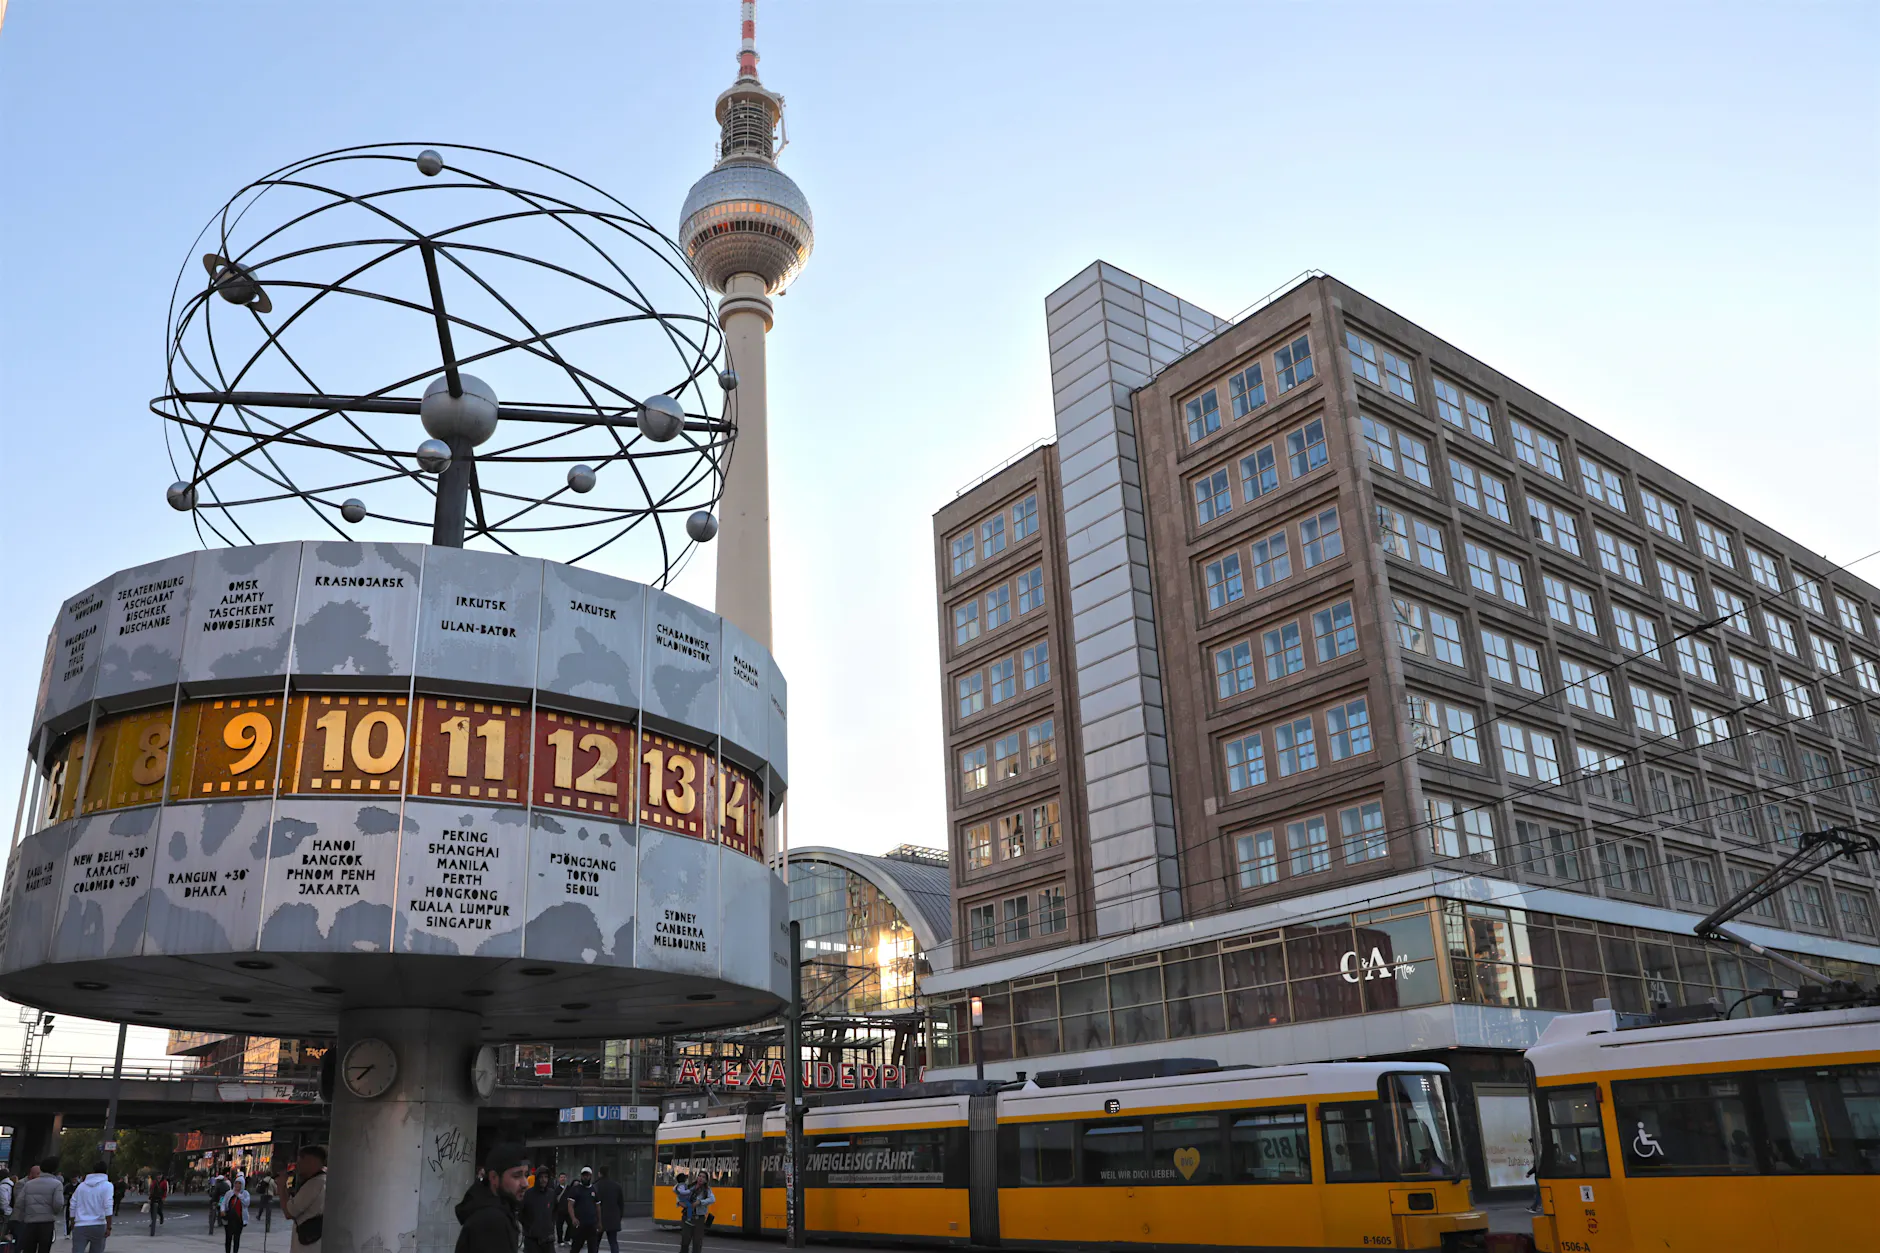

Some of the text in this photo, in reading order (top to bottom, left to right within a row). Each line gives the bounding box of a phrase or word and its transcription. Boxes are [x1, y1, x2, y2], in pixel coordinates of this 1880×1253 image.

[117, 575, 185, 601] JEKATERINBURG
[228, 579, 259, 592] OMSK
[315, 576, 405, 589] KRASNOJARSK
[123, 590, 174, 611] ASCHGABAT
[220, 591, 265, 605] ALMATY
[456, 596, 507, 612] IRKUTSK
[126, 604, 167, 622] BISCHKEK
[209, 603, 274, 619] TASCHKENT
[570, 600, 617, 620] JAKUTSK
[119, 615, 171, 636] DUSCHANBE
[203, 616, 276, 632] NOWOSIBIRSK
[441, 620, 517, 638] ULAN-BATOR
[656, 623, 710, 652] CHABAROWSK
[655, 635, 711, 664] WLADIWOSTOK
[733, 667, 759, 689] SACHALIN
[223, 711, 273, 776] 9
[316, 709, 406, 775] 10
[440, 715, 507, 782] 11
[132, 722, 171, 786] 8
[547, 728, 619, 798] 12
[643, 748, 696, 815] 13
[711, 770, 745, 837] 14
[442, 829, 488, 843] PEKING
[312, 840, 356, 851] HANOI
[428, 843, 500, 858] SHANGHAI
[73, 852, 95, 866] NEW
[98, 849, 125, 863] DELHI
[301, 854, 363, 867] BANGKOK
[550, 853, 616, 872] PJÖNGJANG
[86, 863, 130, 877] KARACHI
[437, 859, 489, 872] MANILA
[168, 871, 217, 885] RANGUN
[287, 869, 376, 881] PHNOM PENH
[442, 873, 482, 886] PERTH
[566, 869, 600, 883] TOKYO
[73, 878, 115, 894] COLOMBO
[184, 885, 227, 897] DHAKA
[299, 884, 361, 896] JAKARTA
[426, 886, 498, 901] HONGKONG
[565, 883, 600, 897] SEOUL
[410, 901, 510, 916] KUALA LUMPUR
[426, 916, 492, 930] SINGAPUR
[664, 909, 697, 924] SYDNEY
[655, 922, 705, 939] CANBERRA
[653, 935, 706, 952] MELBOURNE
[1340, 946, 1416, 983] C&A Alex
[597, 1105, 608, 1119] U
[705, 1156, 717, 1171] DER
[762, 1156, 780, 1171] DER
[805, 1151, 875, 1171] ZWEIGLEISIG
[875, 1148, 915, 1170] FÄHRT.
[1100, 1169, 1177, 1179] WEIL WIR DICH LIEBEN.
[1363, 1235, 1392, 1245] B-1605
[1561, 1241, 1591, 1253] 1506-A
